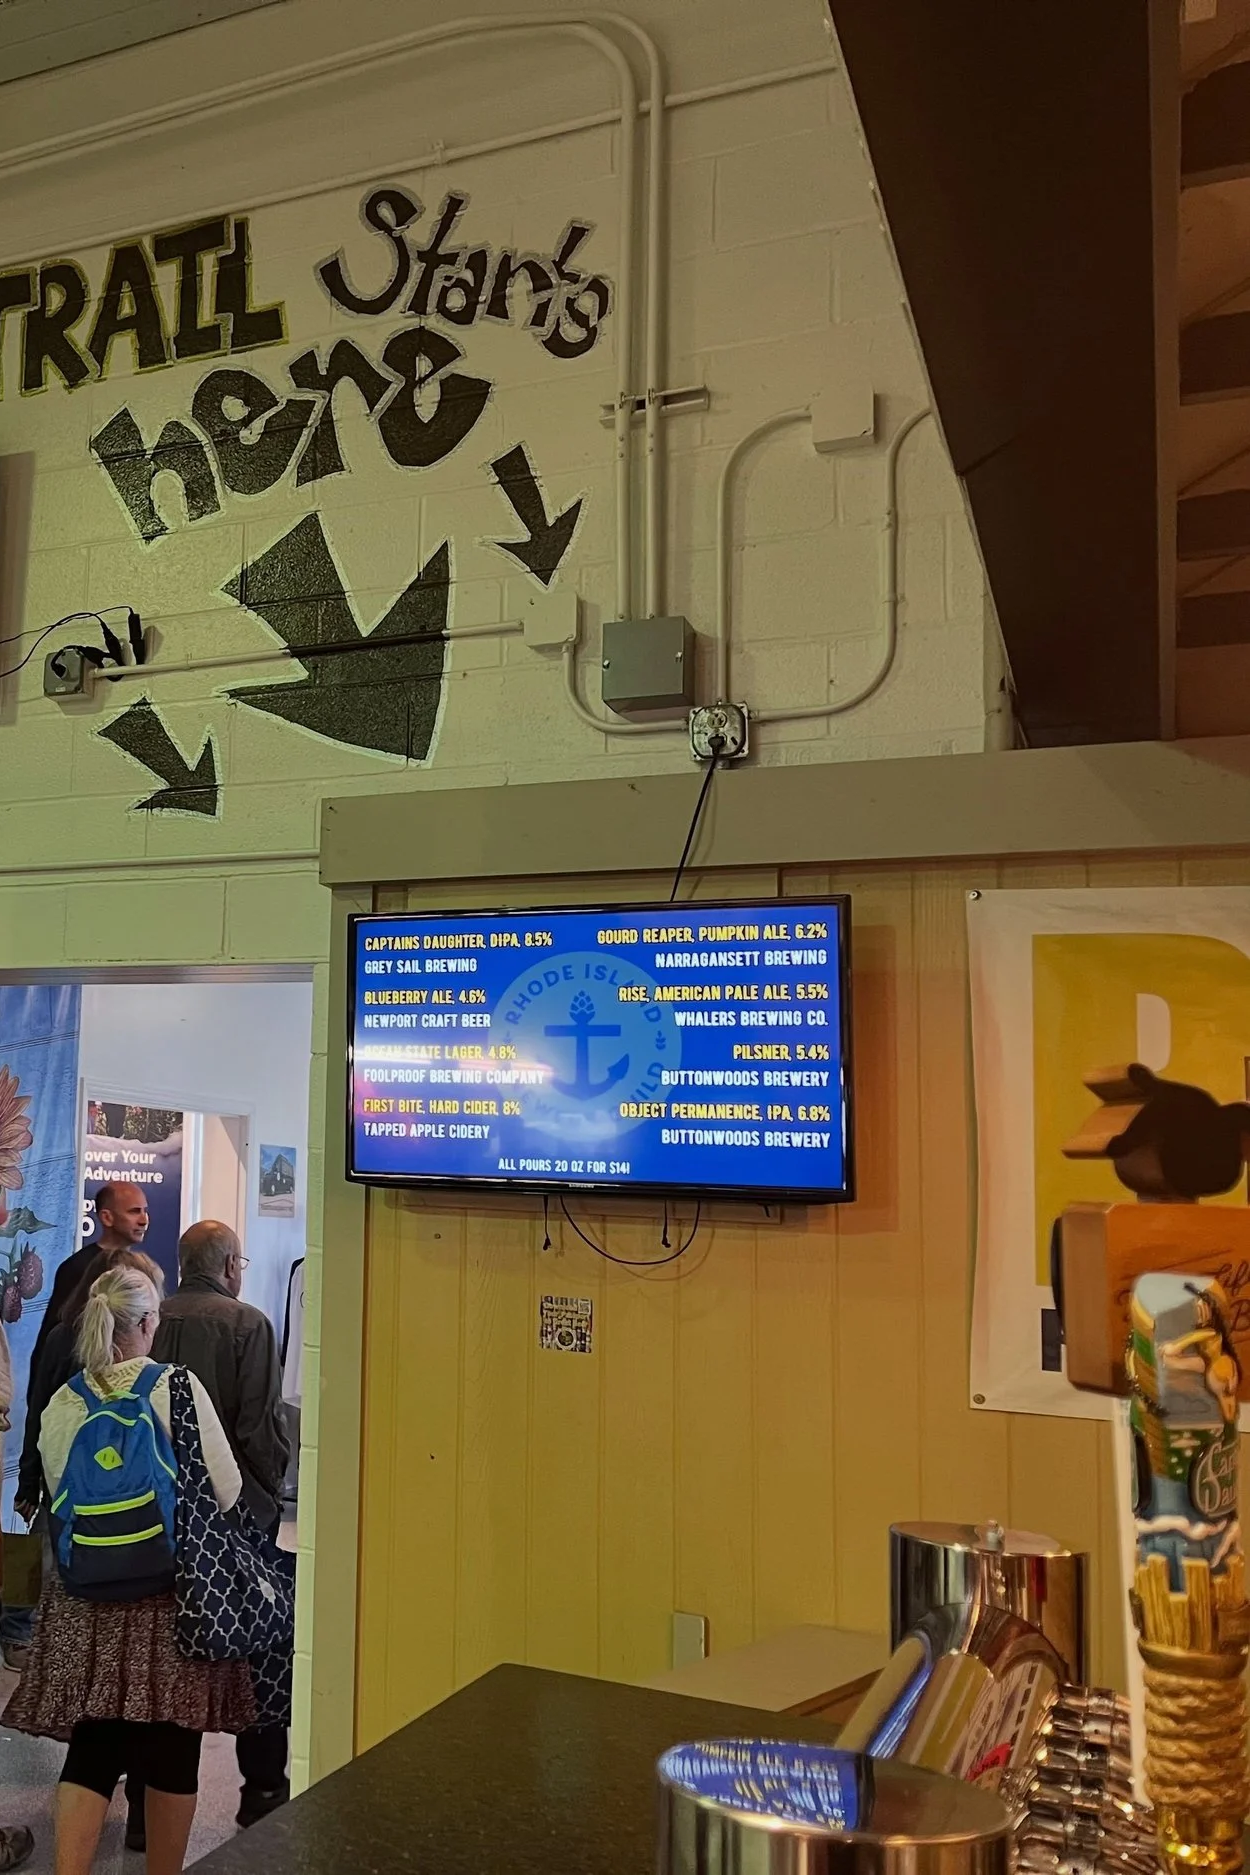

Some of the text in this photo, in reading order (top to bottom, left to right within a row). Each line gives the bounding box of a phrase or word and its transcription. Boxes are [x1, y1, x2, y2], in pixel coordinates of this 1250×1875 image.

[313, 183, 615, 360] Starts
[90, 323, 495, 550] here
[365, 932, 552, 950] CAPTAINS DAUGHTER, DIPA, 8.5%
[597, 923, 827, 944] GOURD REAPER, PUMPKIN ALE, 6.2%
[365, 958, 477, 974] GREY SAIL BREWING
[655, 949, 827, 968] NARRAGANSETT BREWING
[364, 989, 486, 1005] BLUEBERRY ALE, 4.6%
[505, 963, 662, 1025] RHODE ISLD
[618, 983, 828, 1002] RISE, AMERICAN PALE ALE, 5.5%
[364, 1013, 491, 1028] NEWPORT CRAFT BEER
[674, 1010, 828, 1027] WHALERS BREWING CO.
[405, 1045, 441, 1059] STATE
[445, 1045, 484, 1060] LAGER,
[488, 1046, 516, 1060] 4.8%
[733, 1044, 829, 1061] PILSNER, 5.4%
[364, 1069, 544, 1084] FOOLPROOF BREWING COMPANY
[661, 1070, 829, 1087] BUTTONWOODS BREWERY
[363, 1099, 395, 1113] FIRST
[398, 1099, 425, 1114] BITE,
[429, 1100, 459, 1114] HARD
[502, 1101, 520, 1115] 8%
[619, 1103, 830, 1122] OBJECT PERMANENCE, IPA, 6.8%
[363, 1122, 490, 1139] TAPPED APPLE CIDERY
[661, 1129, 830, 1148] BUTTONWOODS BREWERY
[121, 1149, 157, 1164] Your
[498, 1158, 516, 1170] ALL
[519, 1159, 551, 1172] POURS
[554, 1160, 568, 1172] 20
[571, 1160, 584, 1173] OZ
[587, 1161, 607, 1174] FOR
[83, 1166, 164, 1184] Adventure
